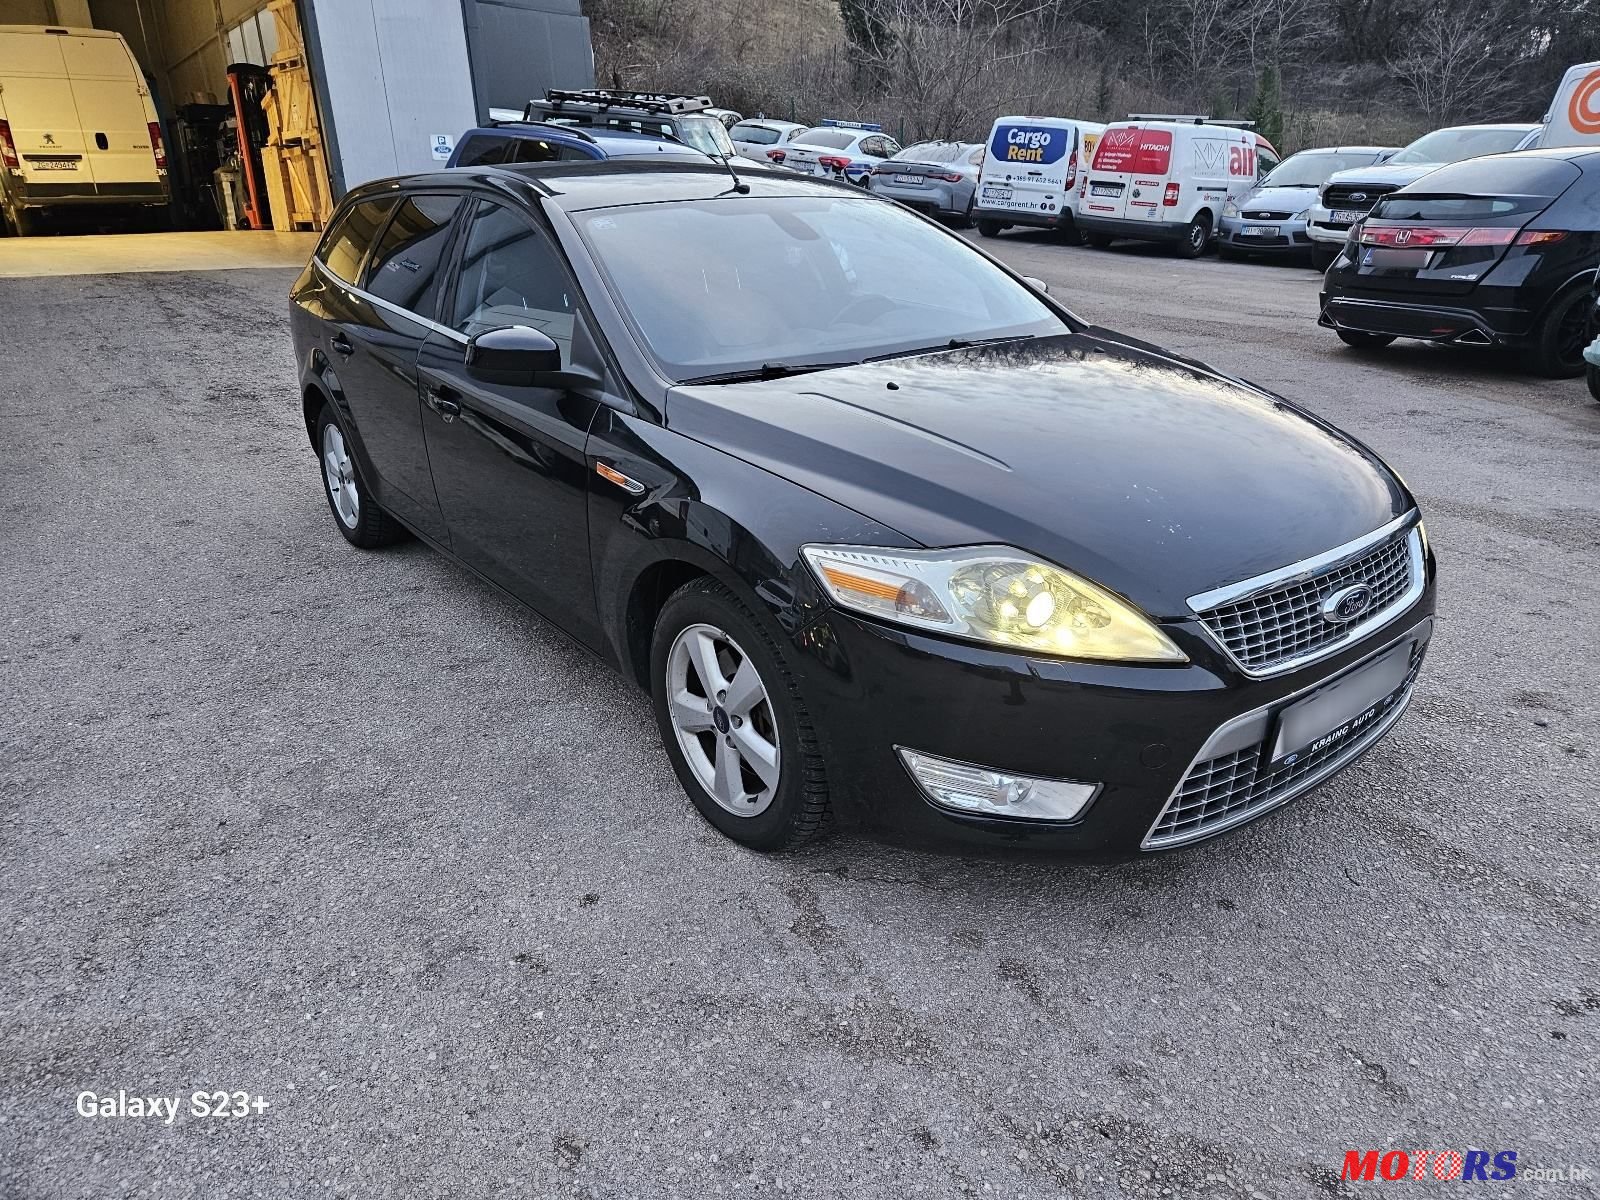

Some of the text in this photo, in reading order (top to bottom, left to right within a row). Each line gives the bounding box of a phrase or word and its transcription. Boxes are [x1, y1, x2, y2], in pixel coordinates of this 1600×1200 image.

[1007, 128, 1051, 149] Cargo
[1139, 143, 1170, 152] HITACHI
[1007, 145, 1043, 161] Rent
[1229, 136, 1256, 177] air
[981, 199, 1039, 209] www.cargorent.hr
[1344, 593, 1366, 616] Ford
[1352, 708, 1375, 729] AUTO
